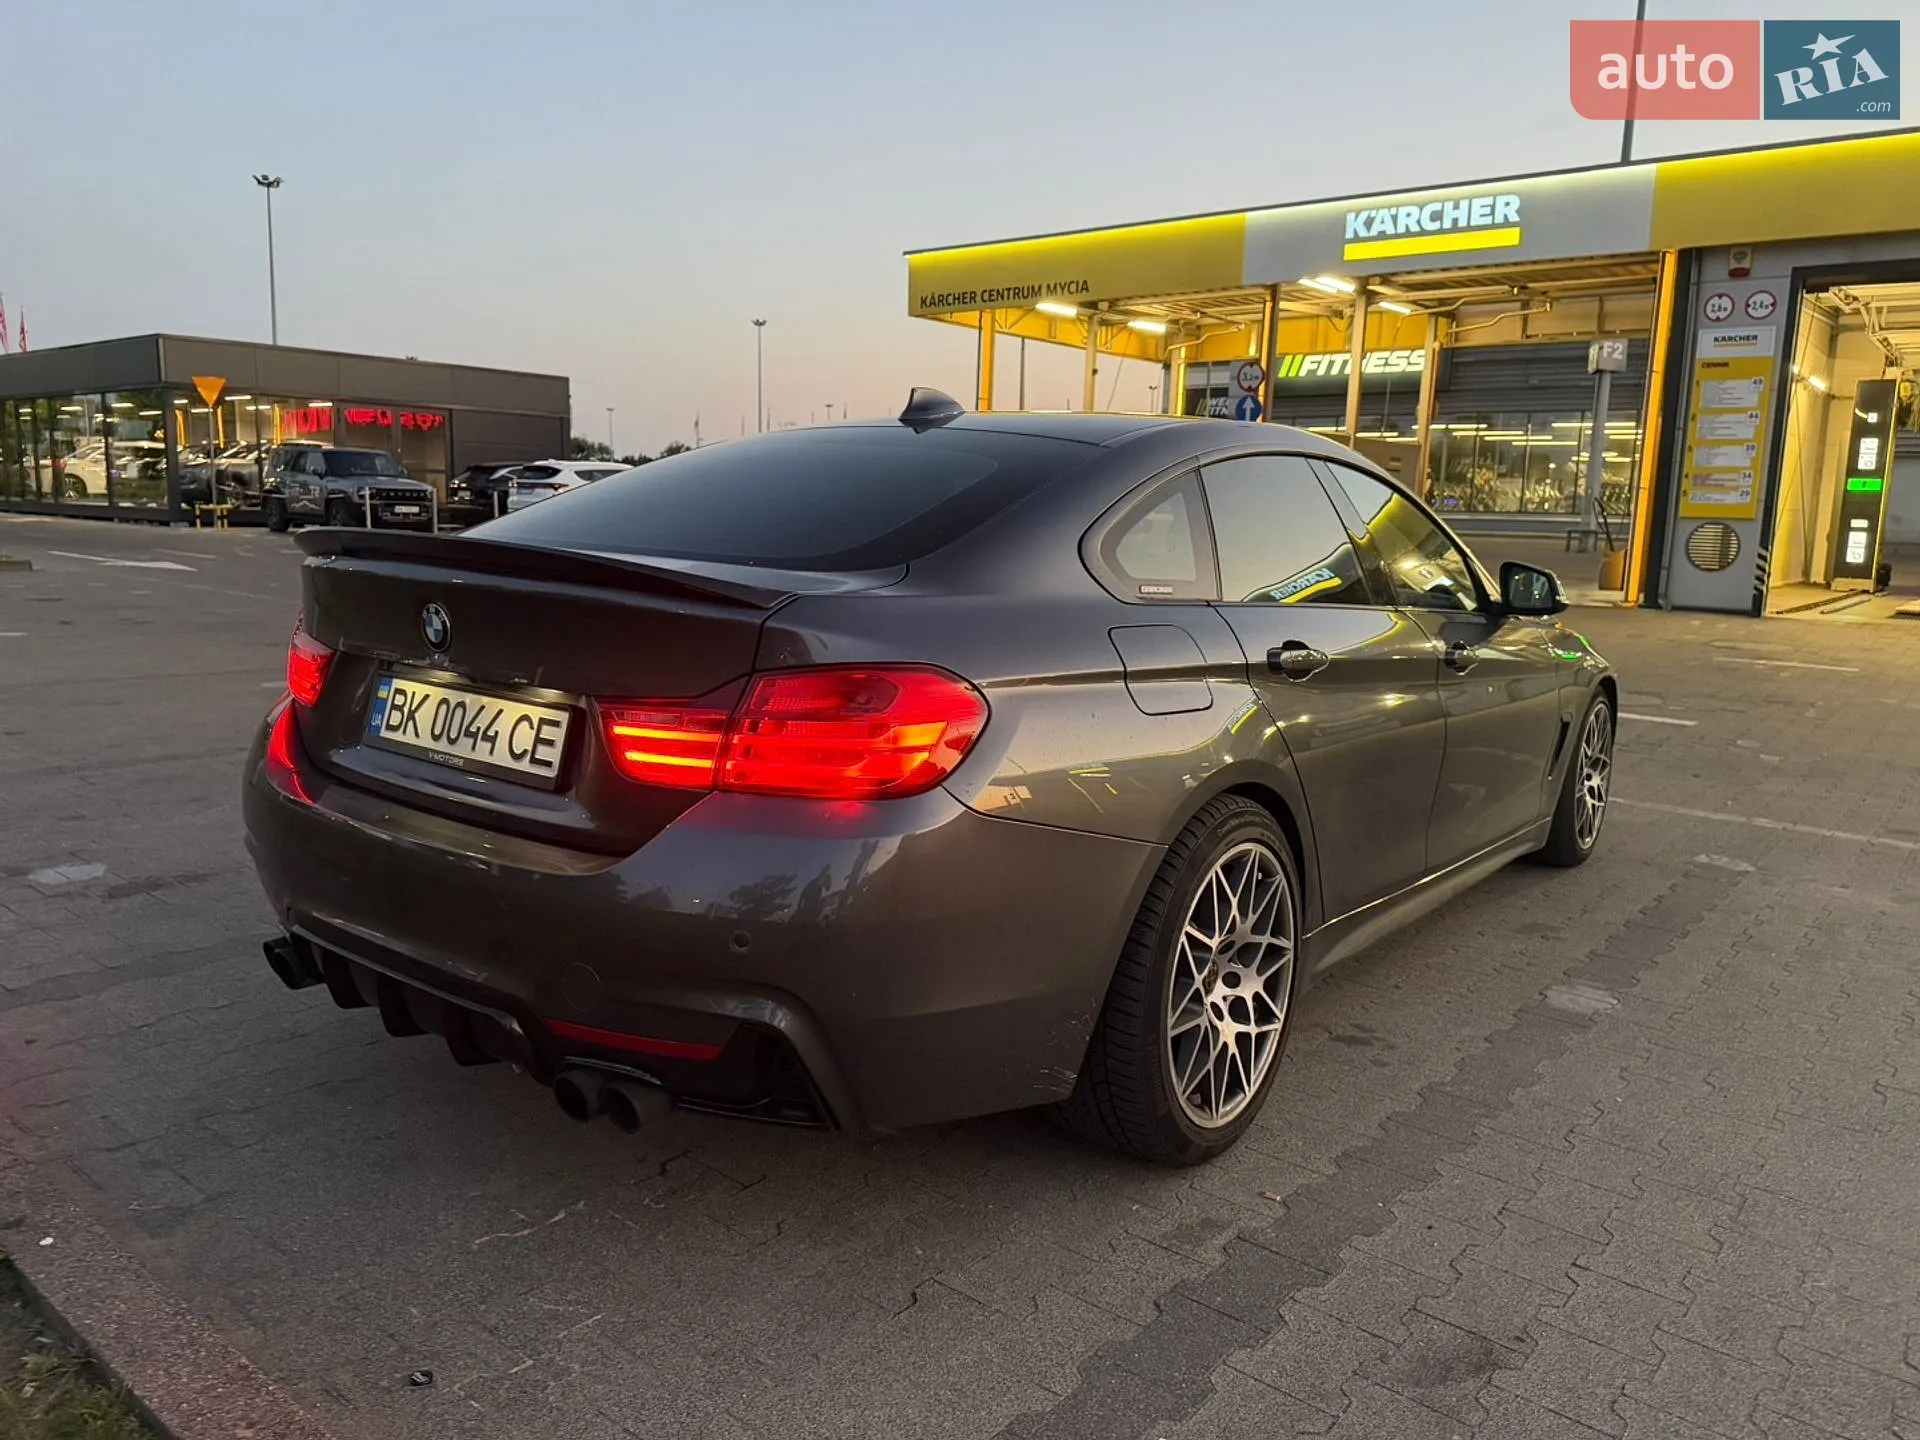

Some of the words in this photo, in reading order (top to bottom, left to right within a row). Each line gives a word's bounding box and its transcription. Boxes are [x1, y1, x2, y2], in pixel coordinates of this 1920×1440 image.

[1345, 194, 1521, 239] KÄRCHER
[920, 290, 977, 309] KÄRCHER
[981, 284, 1042, 303] CENTRUM
[1046, 279, 1090, 297] MYCIA
[1603, 341, 1623, 360] F2
[385, 687, 431, 739] BK
[430, 697, 504, 757] 0044
[508, 713, 561, 769] CE
